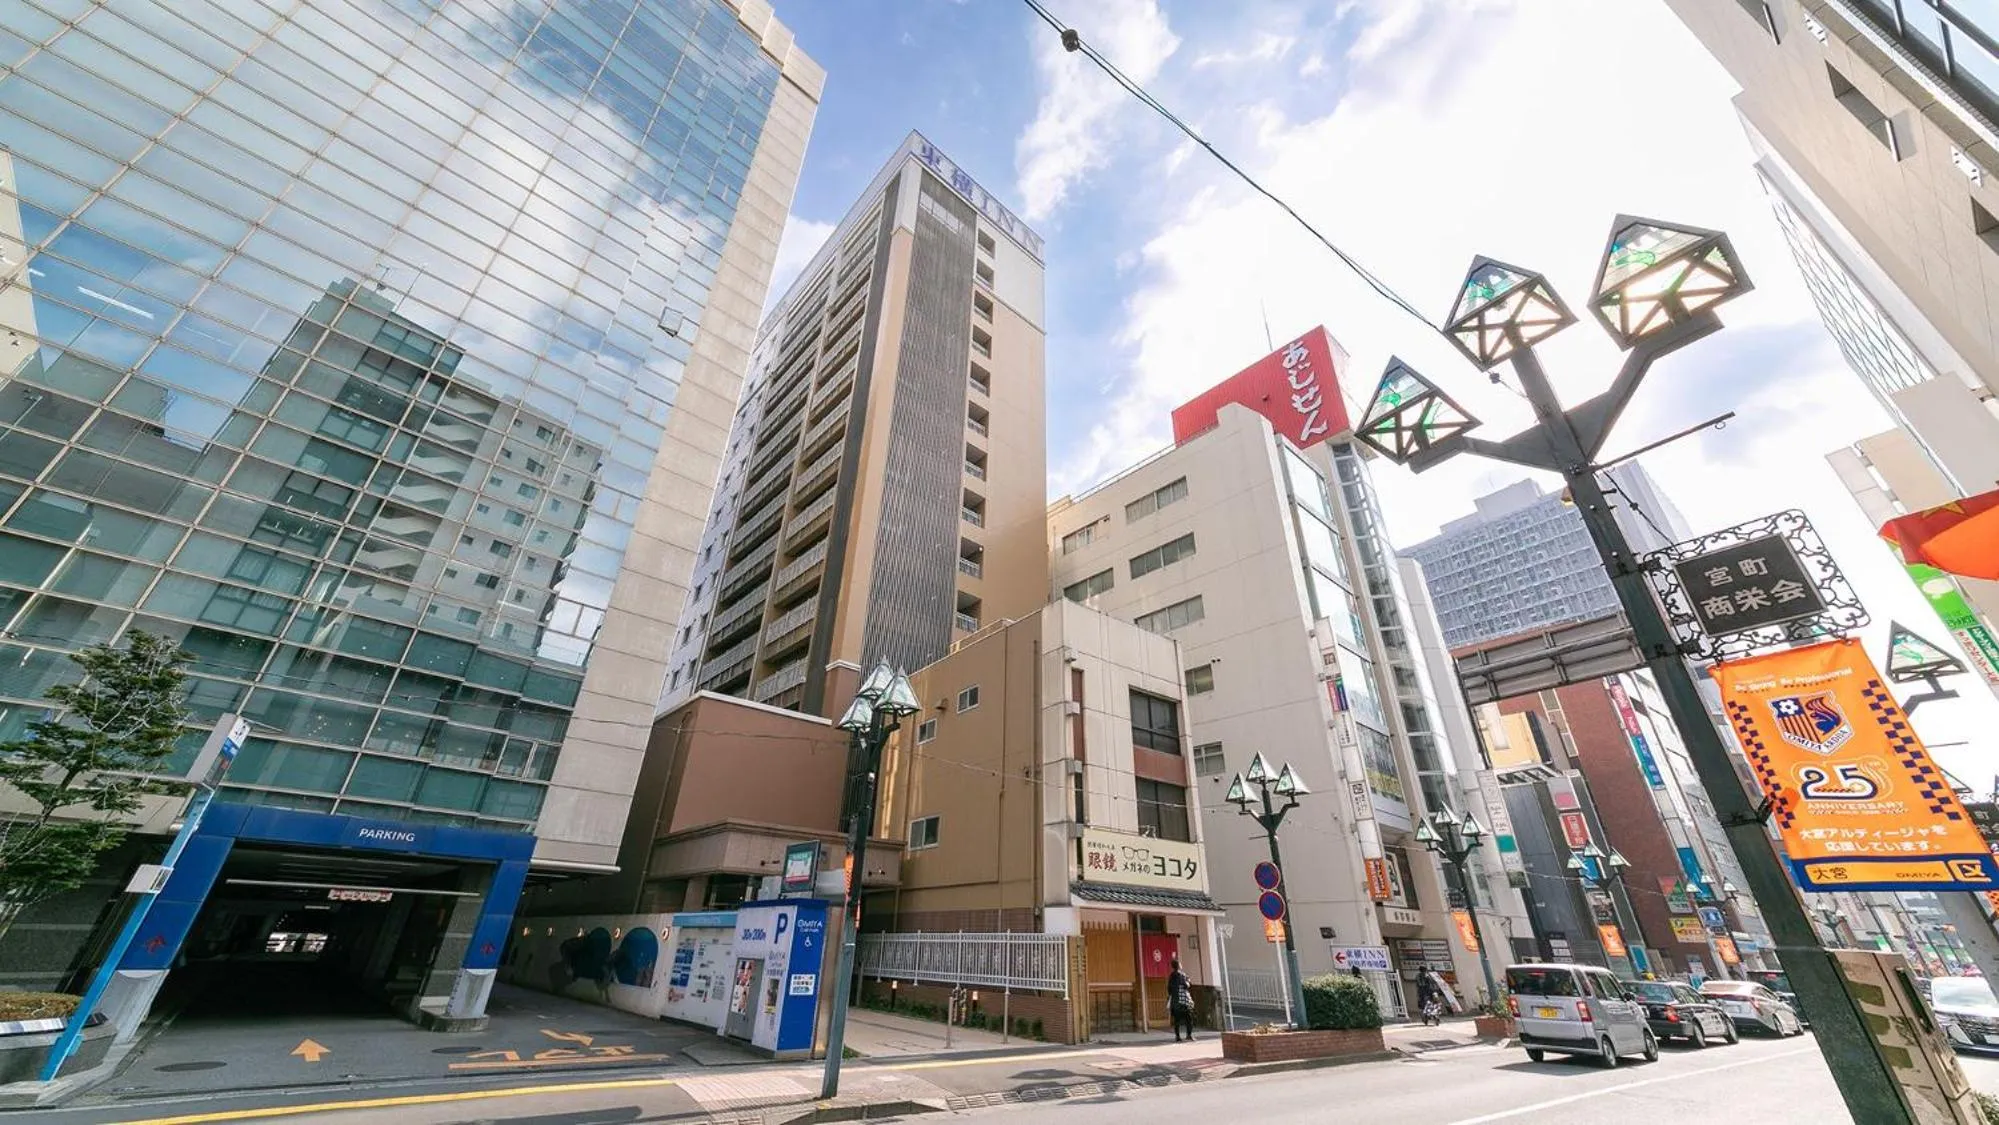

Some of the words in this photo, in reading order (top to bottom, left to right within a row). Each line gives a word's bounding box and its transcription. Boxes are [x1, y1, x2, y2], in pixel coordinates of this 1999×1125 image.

[1281, 340, 1329, 441] あじせん
[1704, 556, 1769, 587] 宮町
[1700, 579, 1807, 620] 商栄会
[1799, 762, 1879, 801] 25
[1807, 801, 1904, 810] ANNIVERSARY
[359, 828, 416, 842] PARKING
[1087, 852, 1118, 872] 眼鏡
[1153, 855, 1198, 880] ヨコタ
[1812, 866, 1848, 880] 大宮
[1346, 949, 1385, 960] 東横INN
